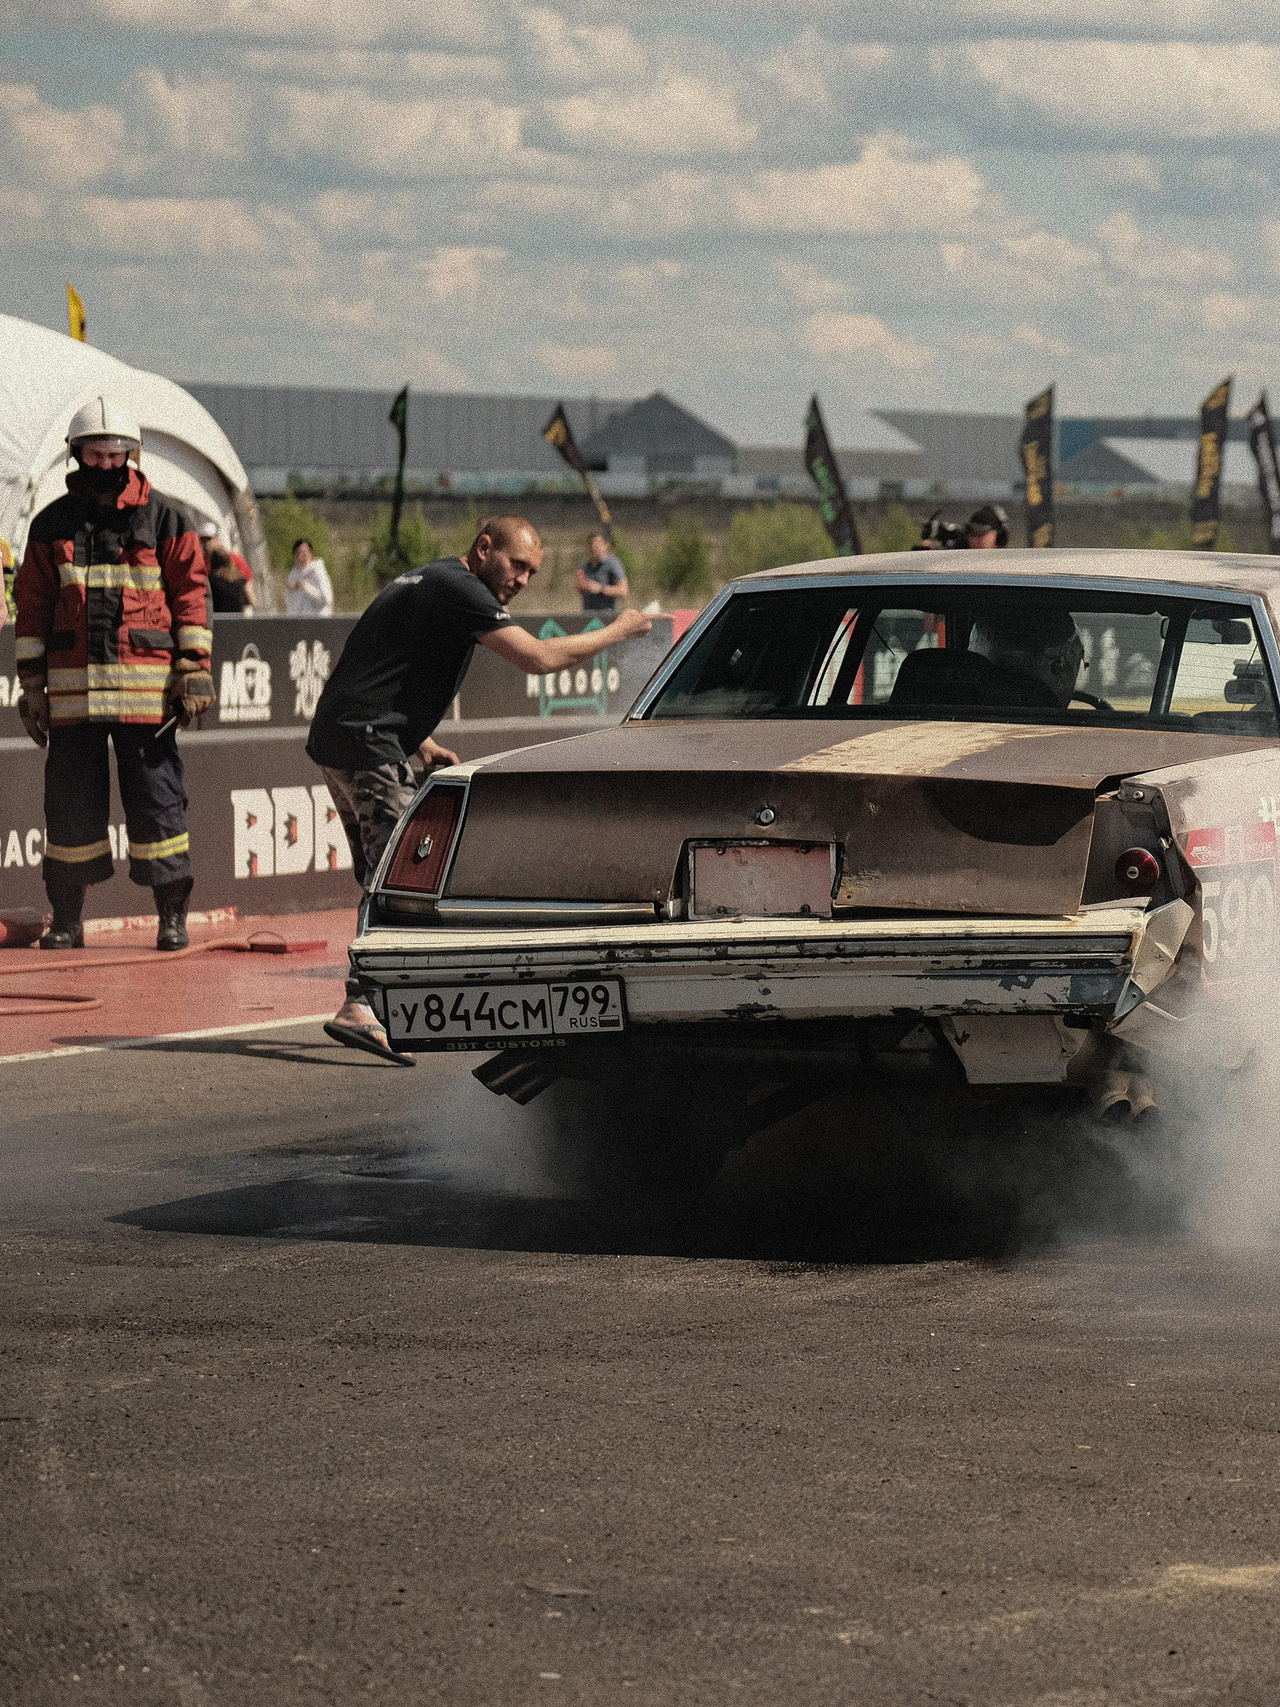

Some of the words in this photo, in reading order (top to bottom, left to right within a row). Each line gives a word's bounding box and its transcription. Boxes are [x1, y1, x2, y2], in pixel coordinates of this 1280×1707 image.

[552, 985, 610, 1016] 799
[570, 1016, 598, 1029] RUS
[484, 1039, 567, 1050] CUSTOMS
